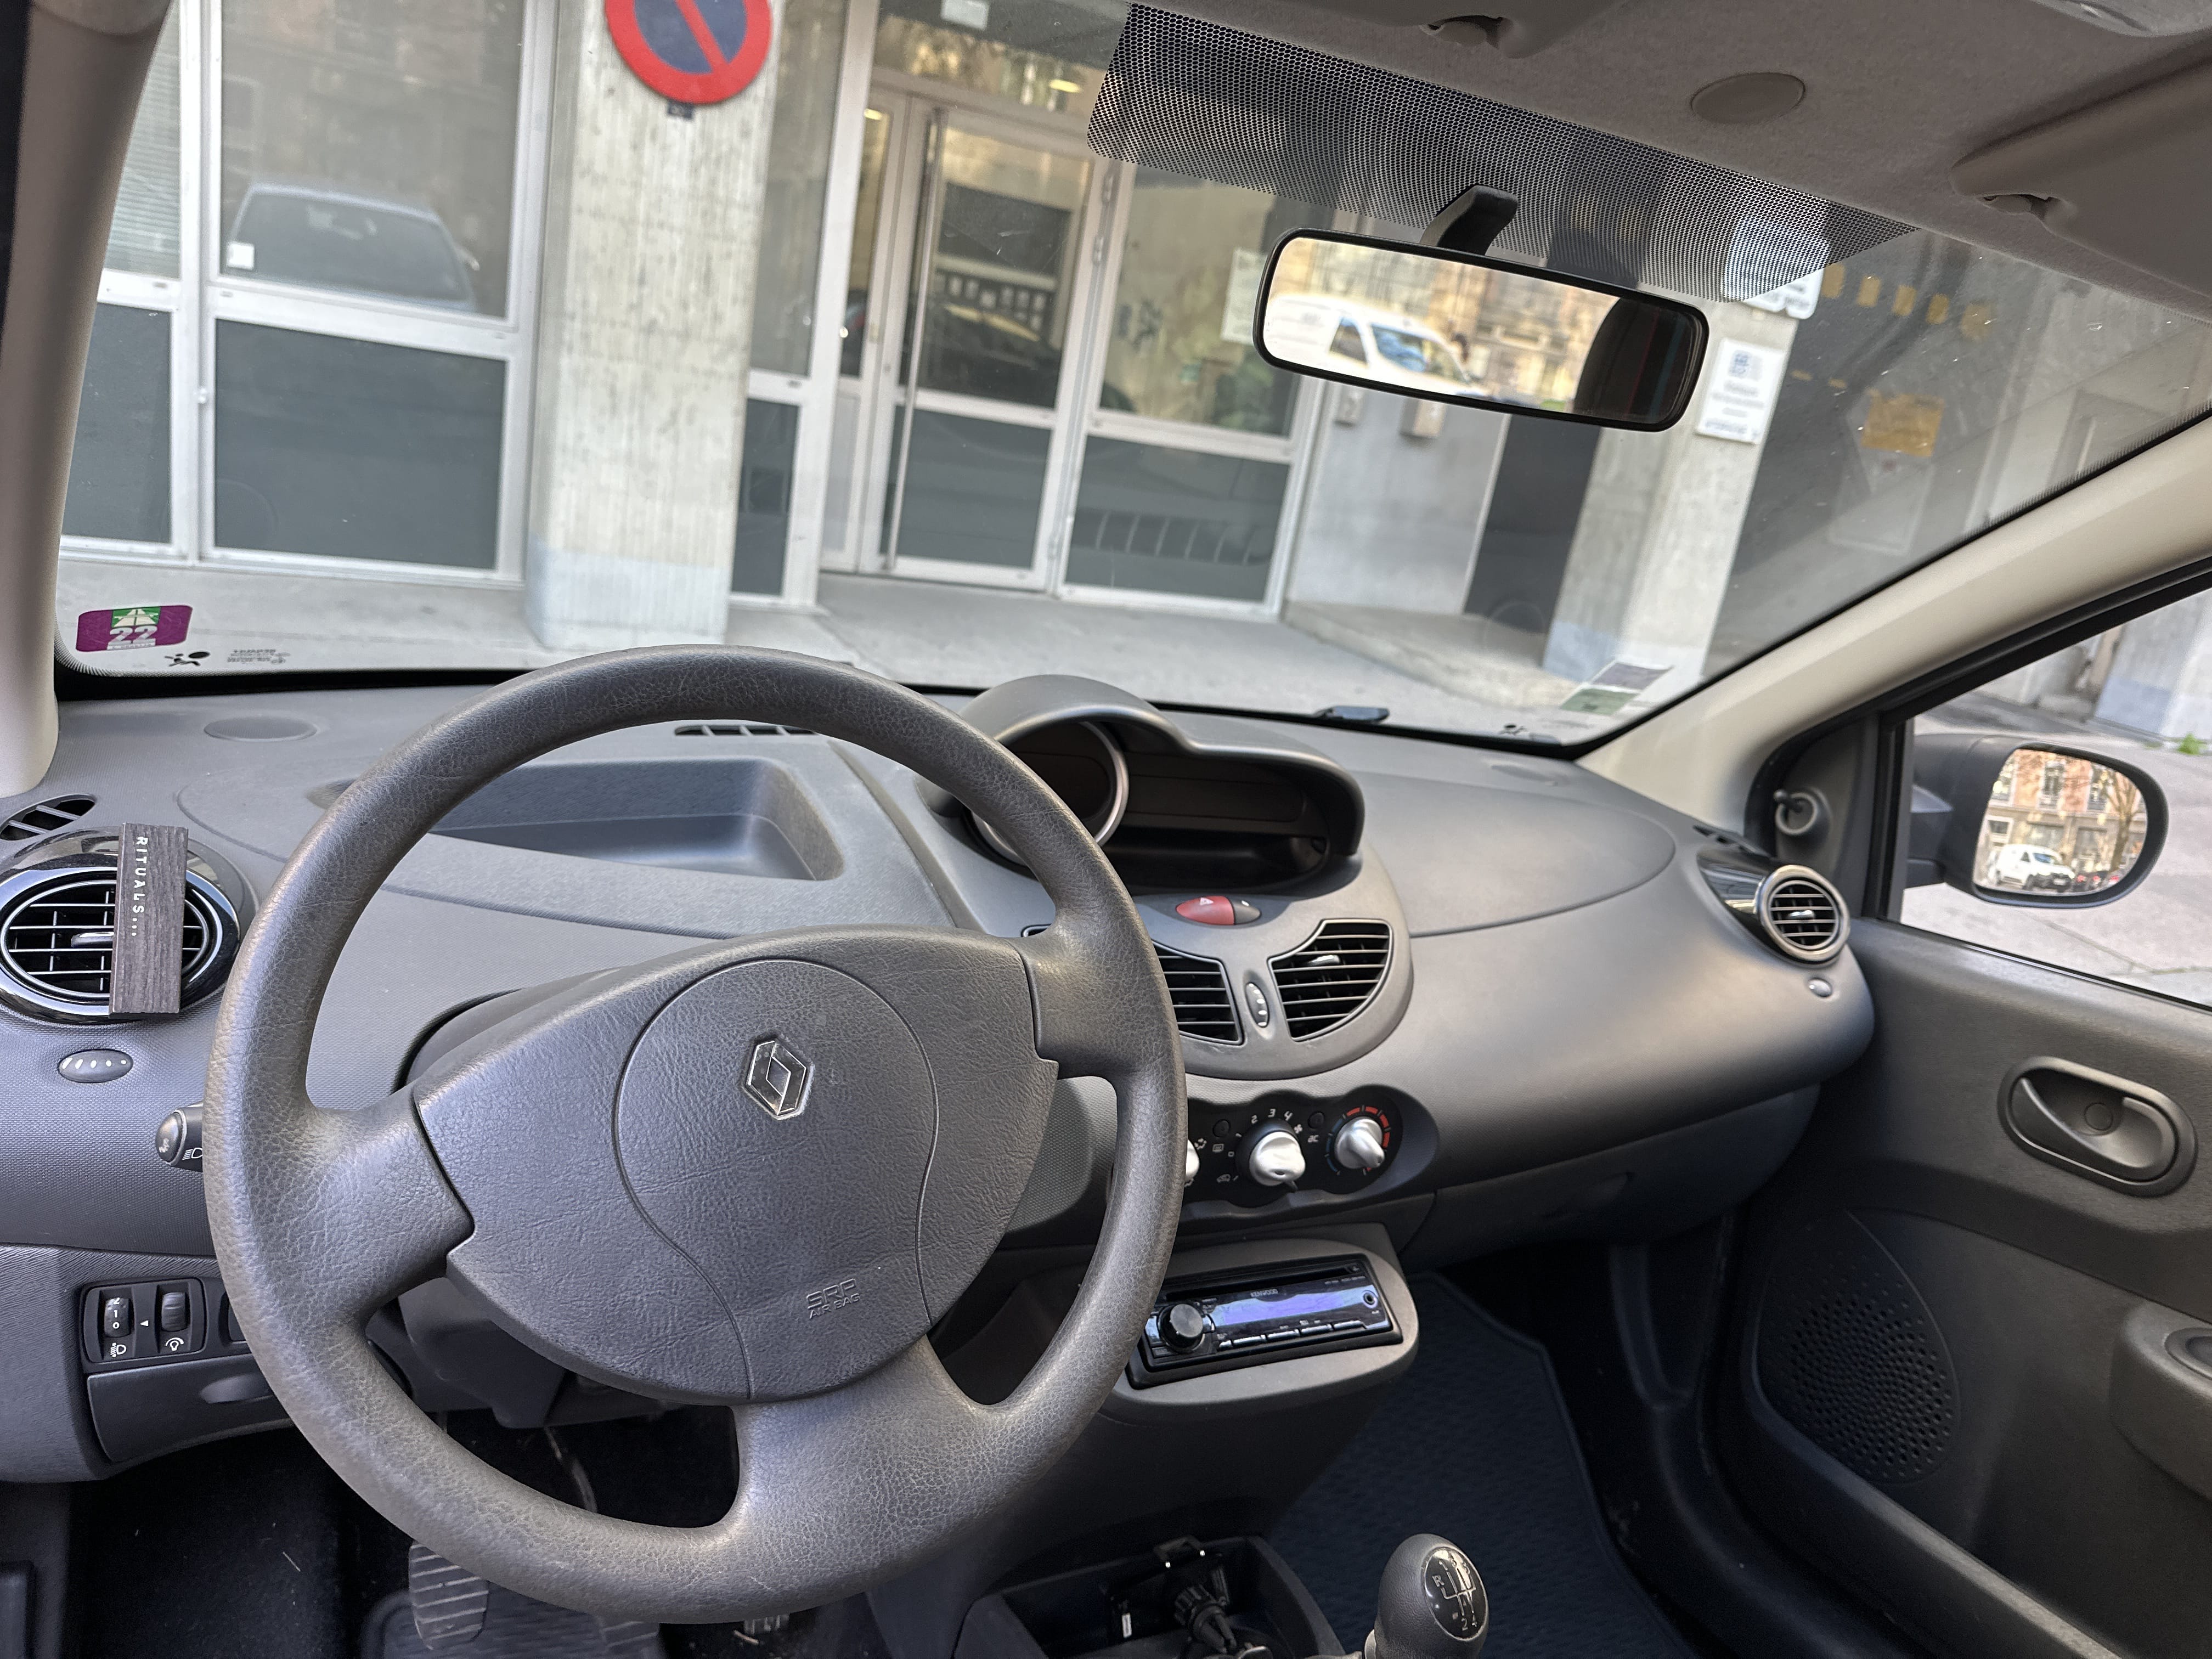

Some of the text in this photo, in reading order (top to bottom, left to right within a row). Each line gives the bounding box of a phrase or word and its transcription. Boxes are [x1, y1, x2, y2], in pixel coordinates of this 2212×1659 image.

[108, 625, 157, 646] 22
[131, 836, 149, 936] RITUALS...
[1268, 1108, 1276, 1118] 3
[1284, 1111, 1293, 1121] 4
[1251, 1115, 1258, 1124] 2
[806, 1278, 856, 1309] SRP
[1250, 1289, 1278, 1297] KENWOOD
[809, 1293, 860, 1319] AIR BAG
[114, 1310, 118, 1318] 1
[1432, 1575, 1445, 1587] R
[1461, 1617, 1469, 1631] 2
